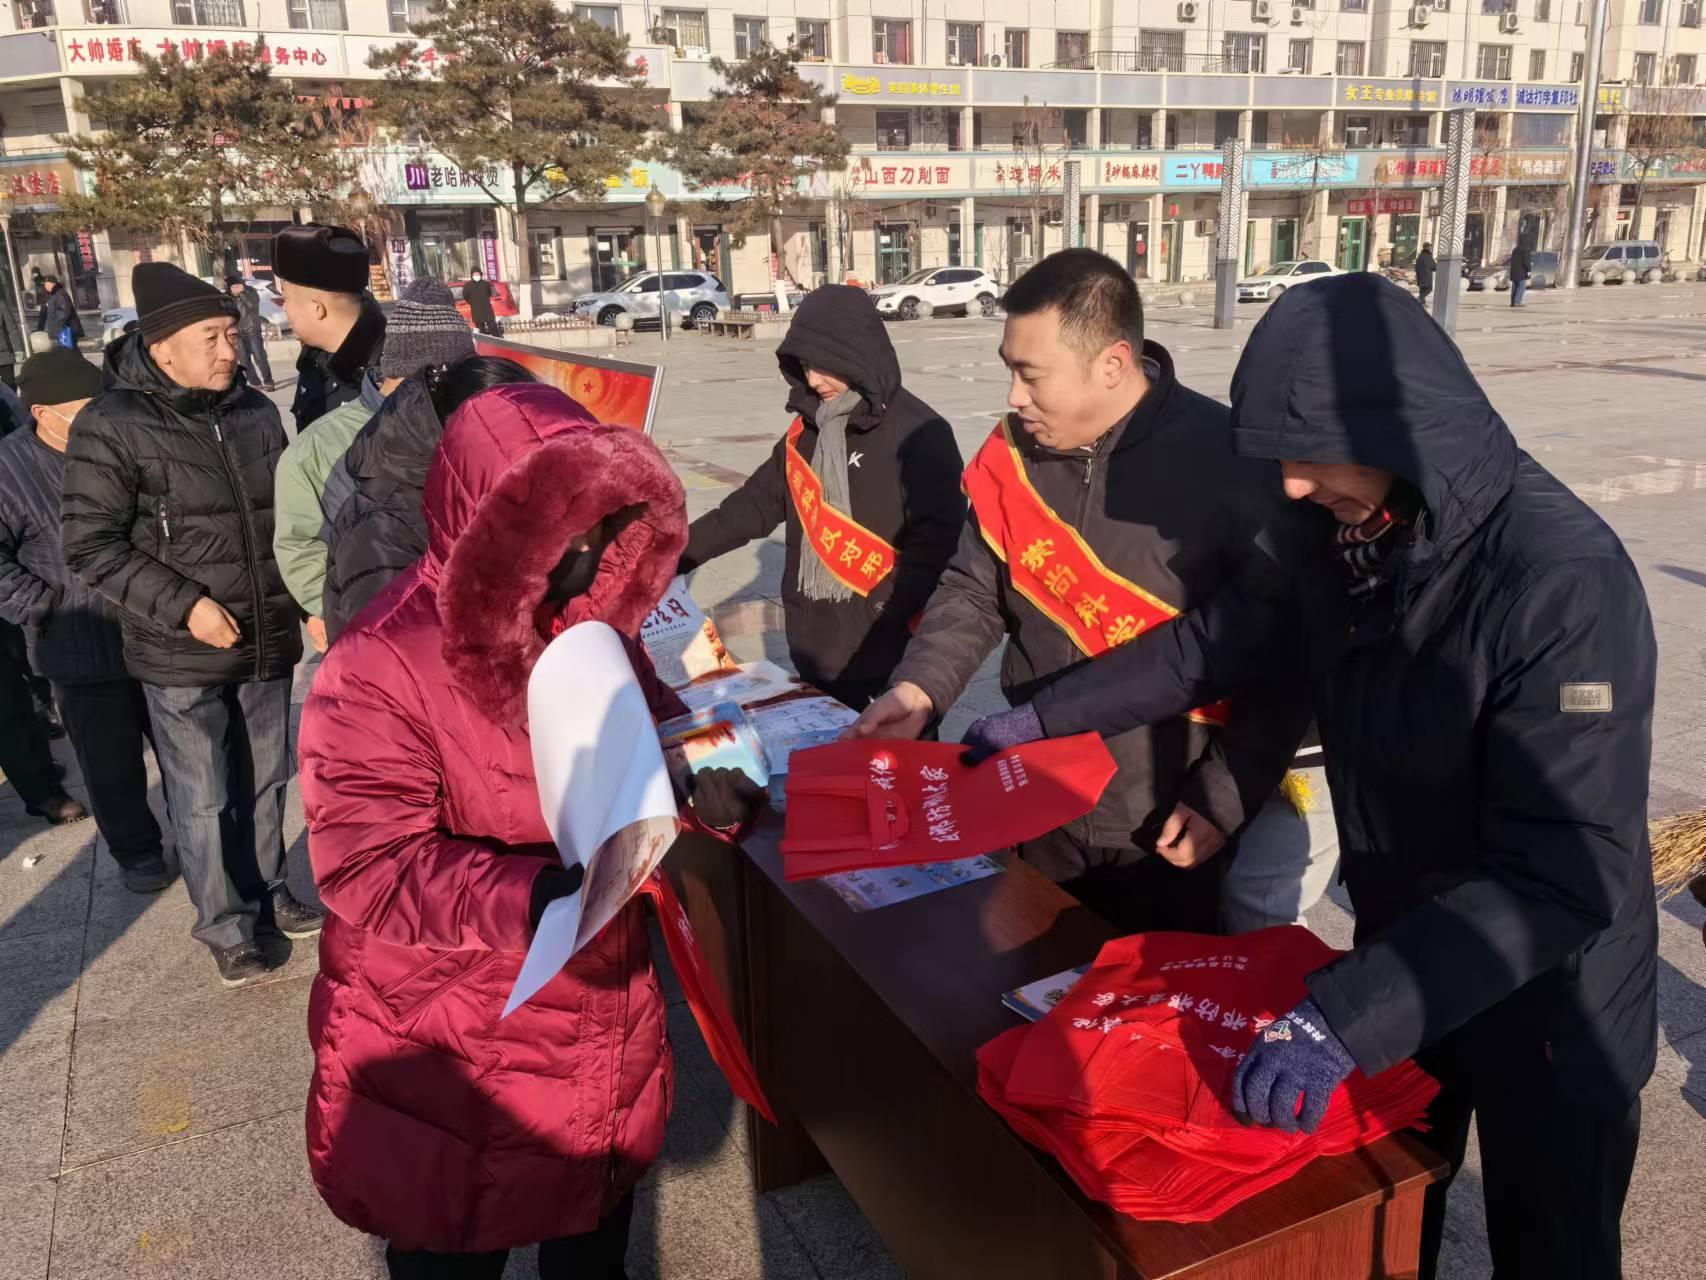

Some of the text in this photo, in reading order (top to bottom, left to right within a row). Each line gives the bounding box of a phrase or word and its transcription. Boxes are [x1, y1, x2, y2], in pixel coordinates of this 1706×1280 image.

[864, 165, 950, 184] 山西刀削面
